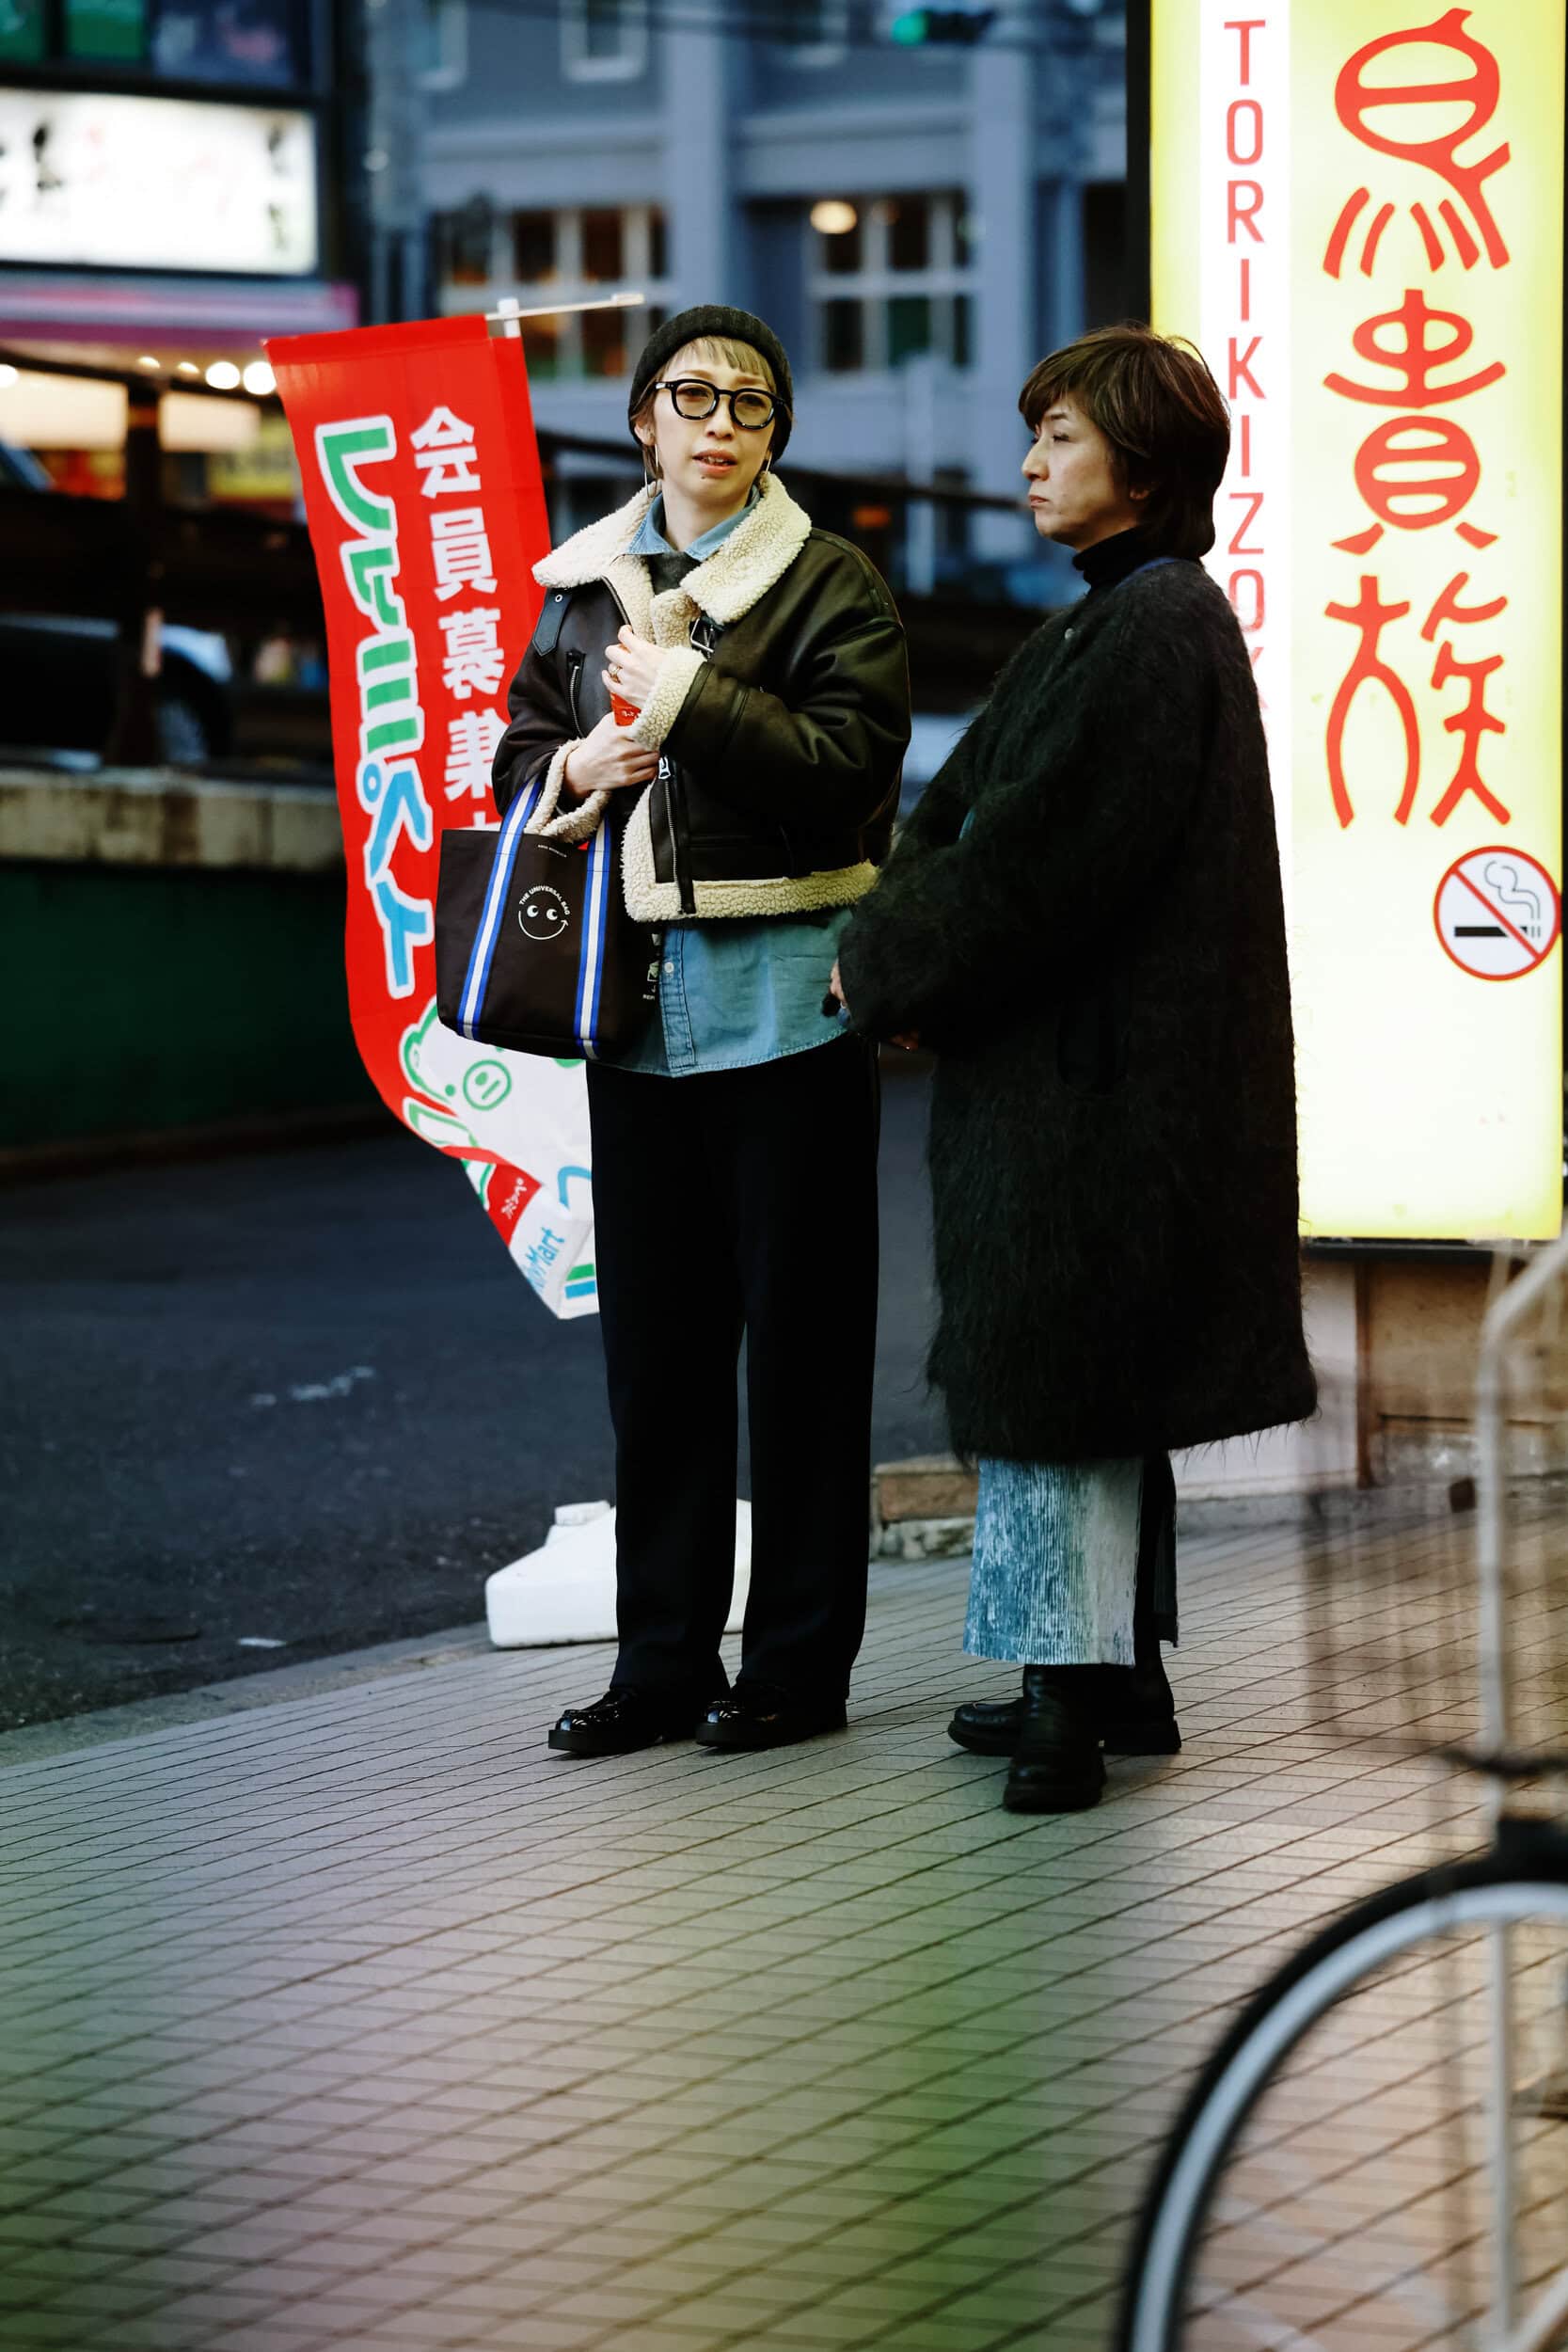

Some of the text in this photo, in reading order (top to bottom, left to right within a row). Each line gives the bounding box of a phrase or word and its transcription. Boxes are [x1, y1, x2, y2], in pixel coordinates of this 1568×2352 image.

[1323, 8, 1511, 830] 鳥貴族
[518, 892, 531, 905] THE
